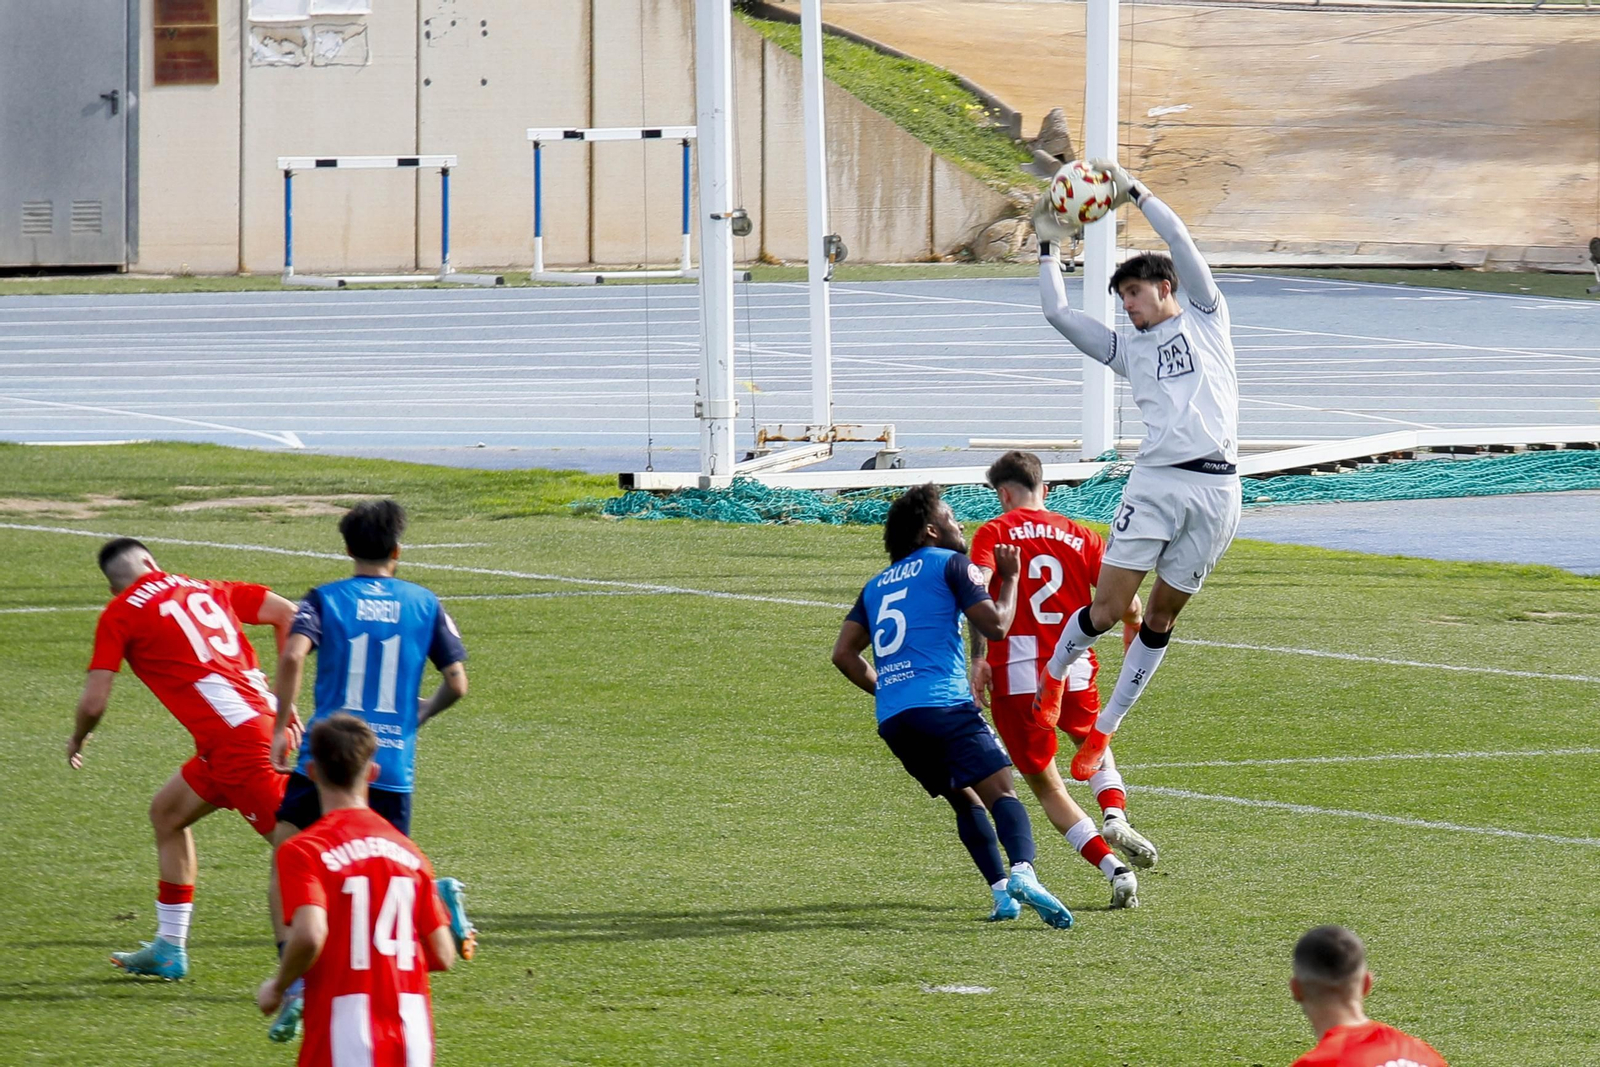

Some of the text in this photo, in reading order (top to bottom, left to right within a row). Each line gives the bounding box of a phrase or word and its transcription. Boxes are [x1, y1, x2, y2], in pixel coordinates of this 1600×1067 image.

[874, 586, 908, 658] 5
[1028, 554, 1063, 625] 2
[158, 591, 240, 664] 19
[342, 632, 401, 714] 11
[341, 875, 417, 971] 14
